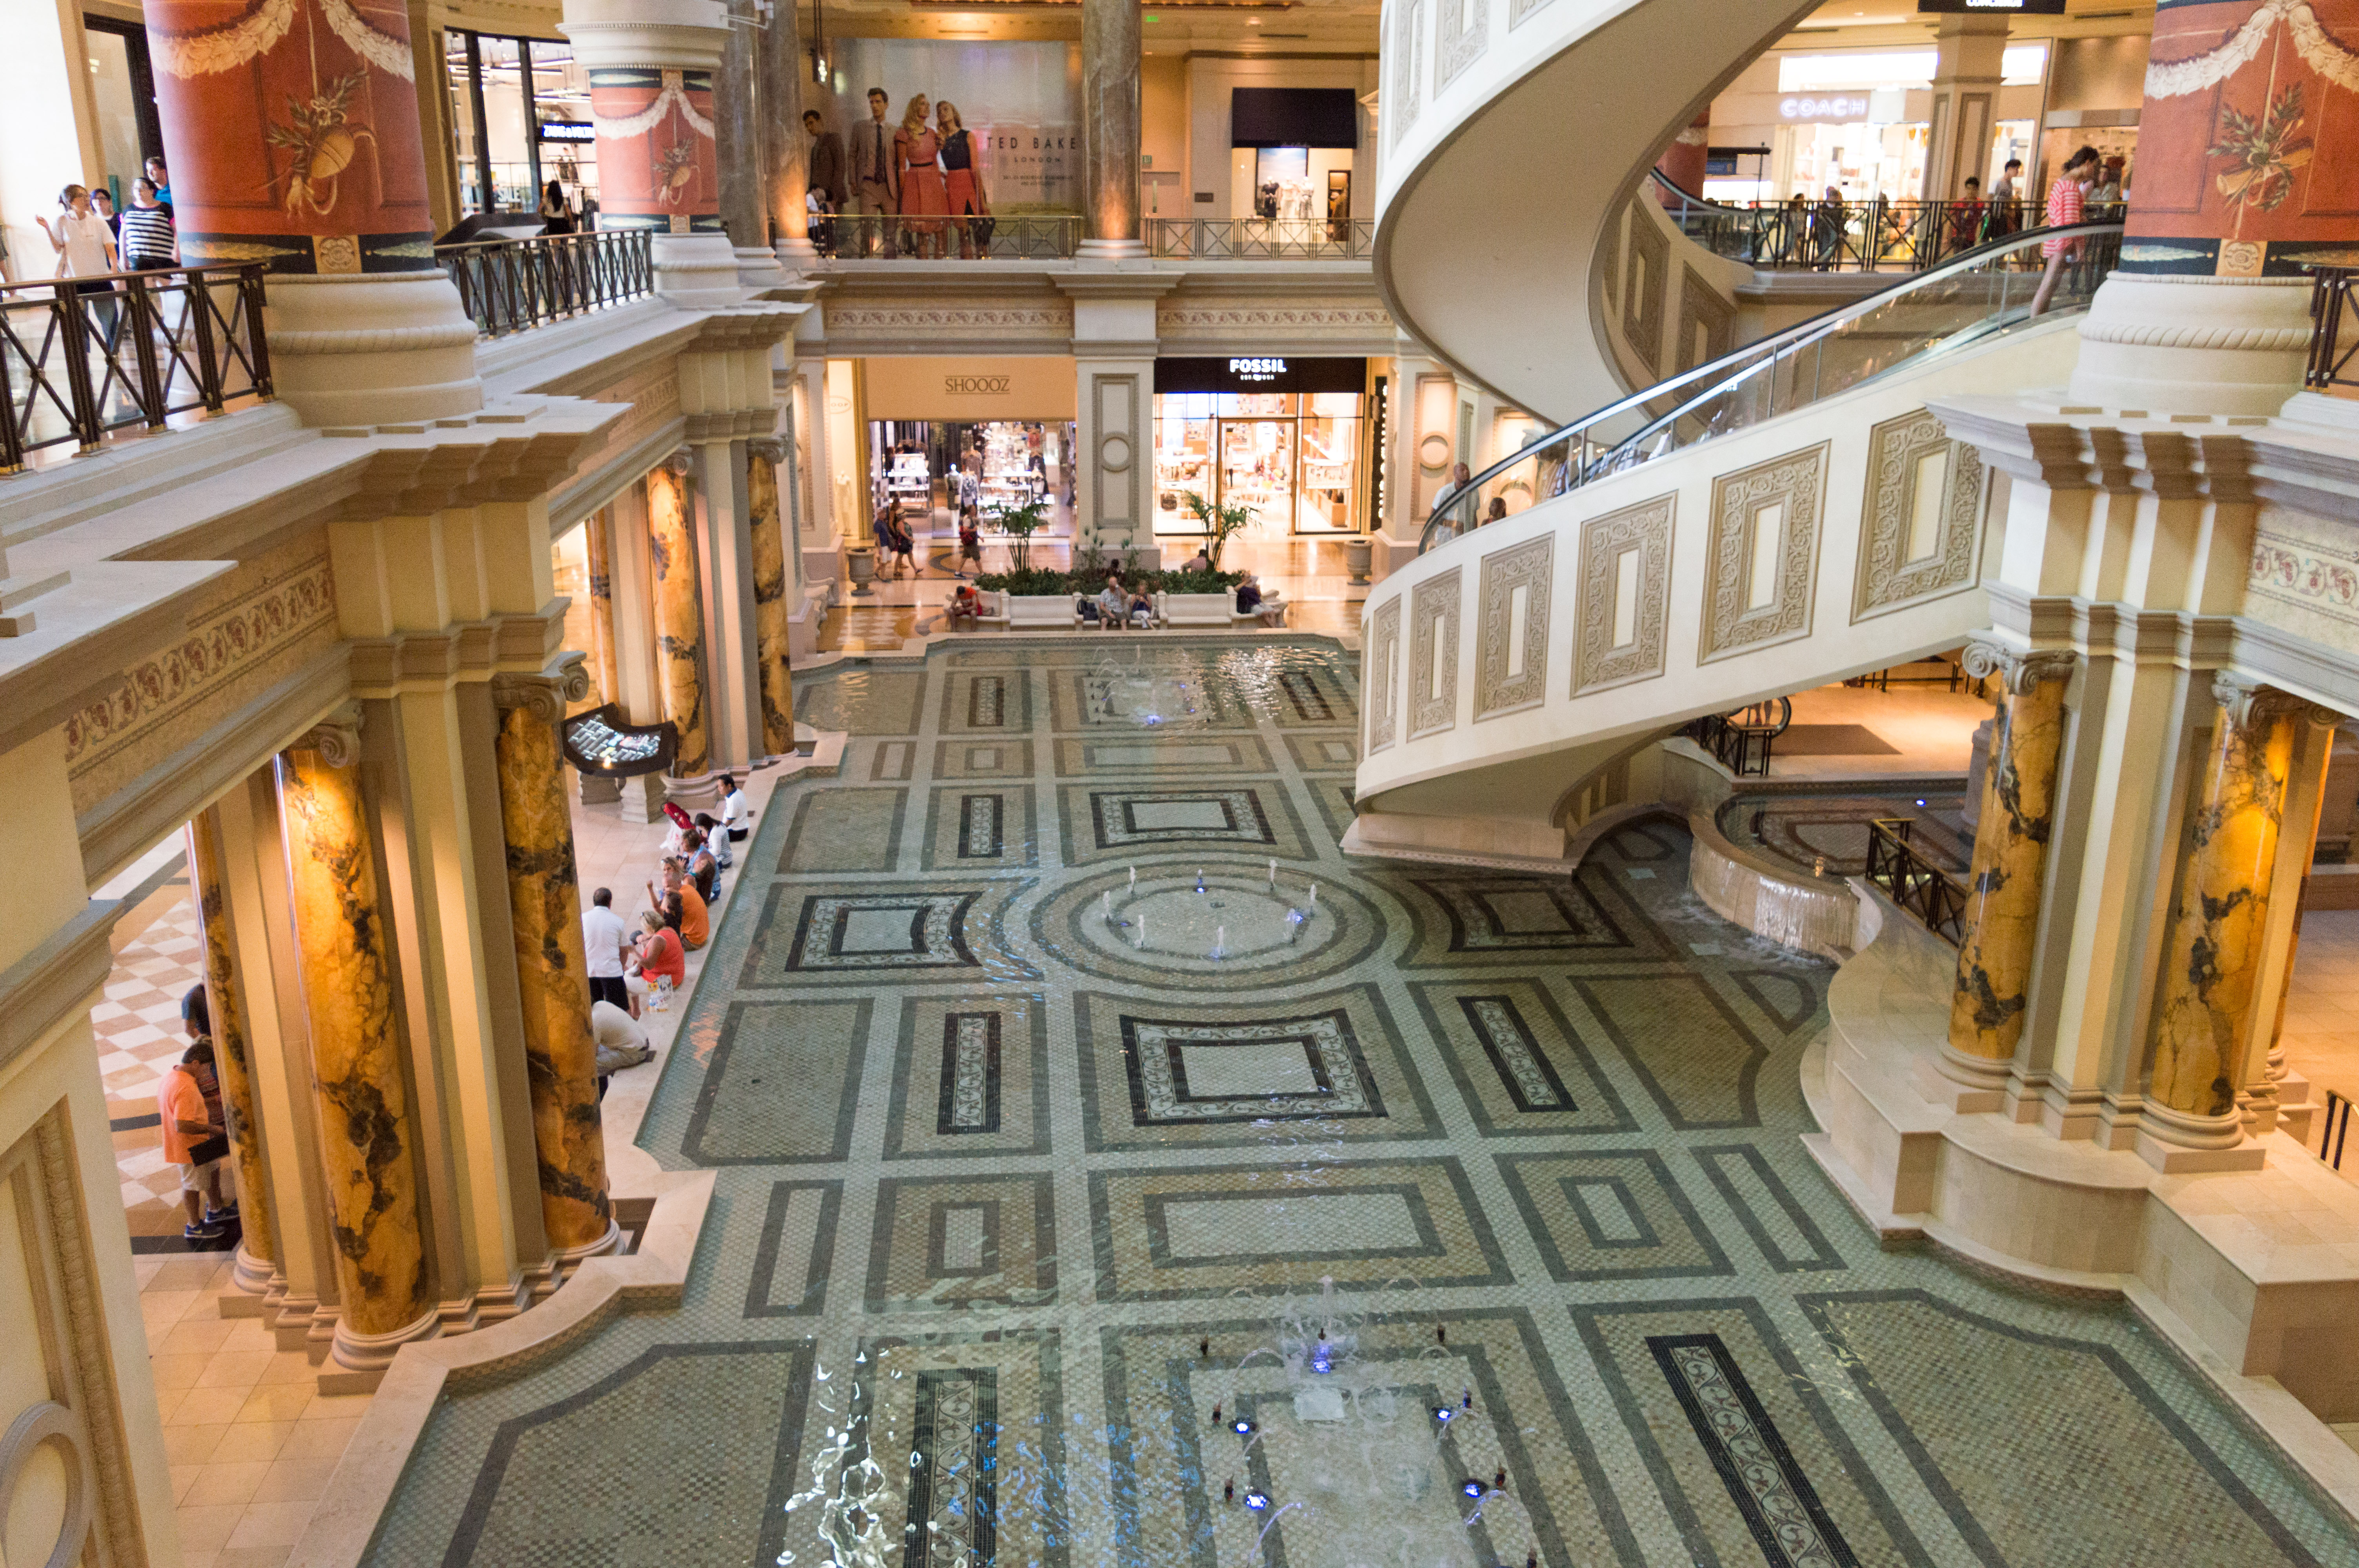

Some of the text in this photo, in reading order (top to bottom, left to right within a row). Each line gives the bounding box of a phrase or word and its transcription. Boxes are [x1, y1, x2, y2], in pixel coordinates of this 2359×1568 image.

[1780, 98, 1867, 117] COACH
[988, 137, 1018, 149] TED
[497, 187, 521, 203] SALE
[1229, 358, 1287, 373] FOSSIL
[945, 378, 1010, 392] SHOOOZ
